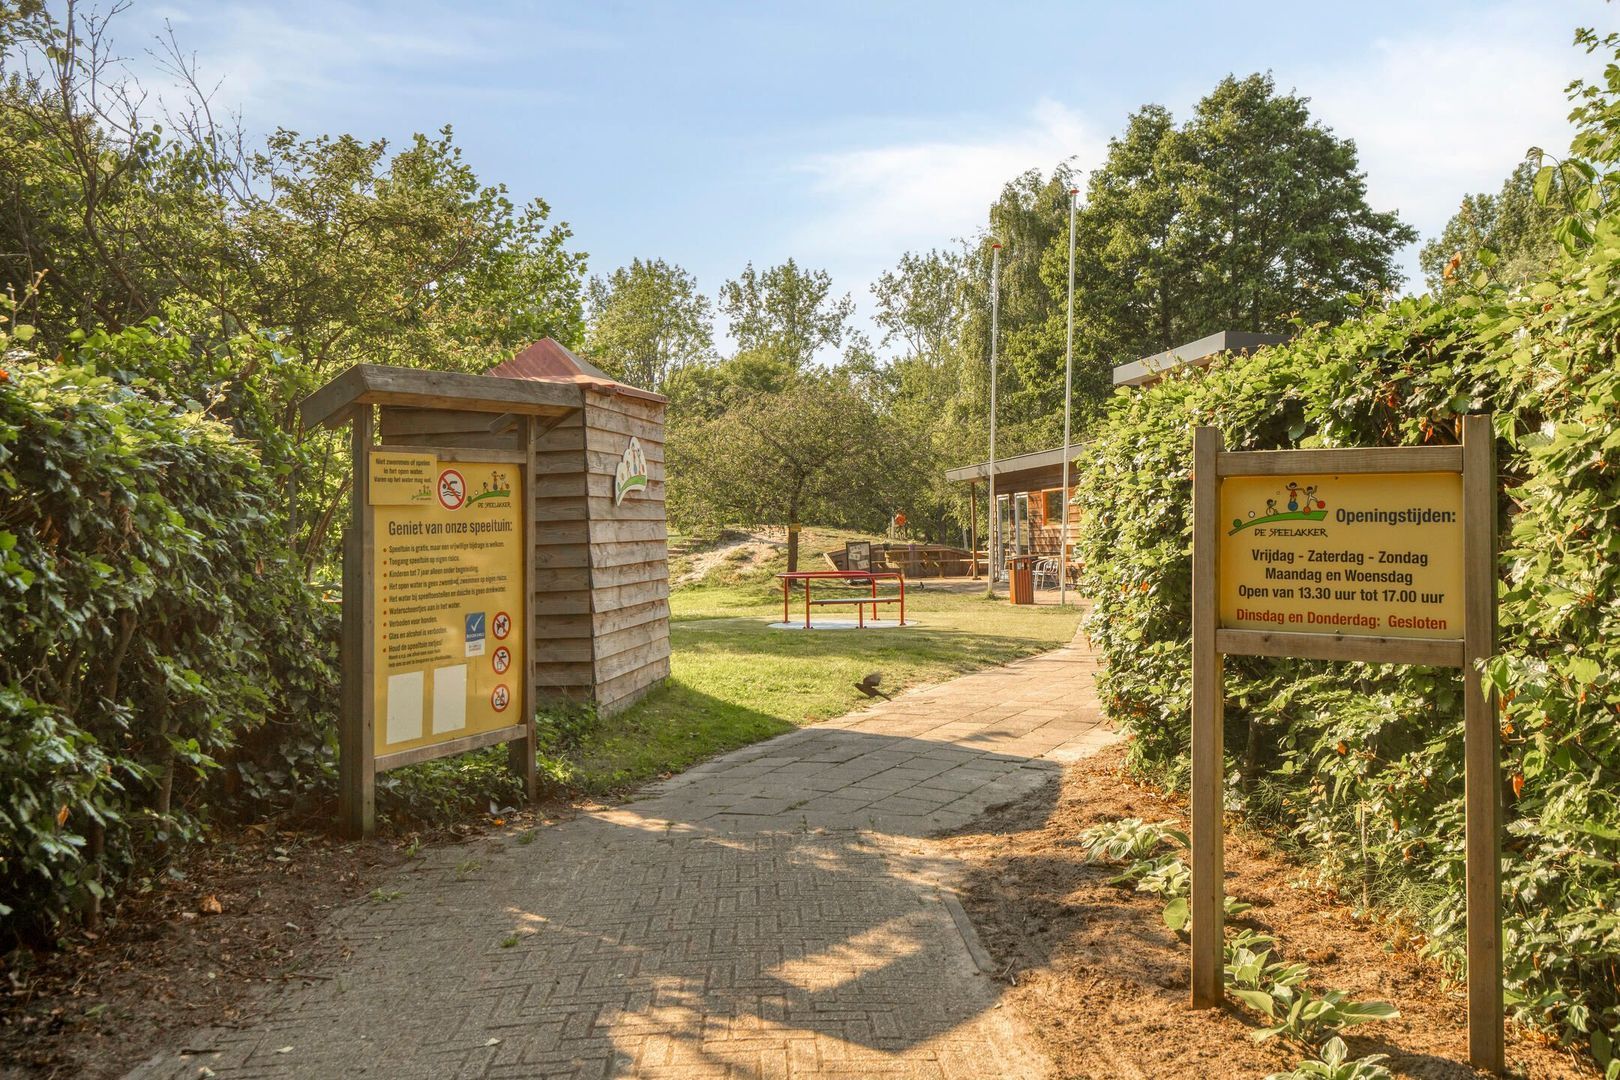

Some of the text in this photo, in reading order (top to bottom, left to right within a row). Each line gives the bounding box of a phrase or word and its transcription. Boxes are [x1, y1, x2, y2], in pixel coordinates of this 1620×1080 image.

[1336, 508, 1456, 526] Openingstijden:
[388, 519, 512, 536] Geniet van onze speeltuin:
[1254, 528, 1328, 538] DE SPEELAKKER
[1252, 549, 1294, 564] Vrijdag
[1308, 550, 1364, 566] Zaterdag
[1378, 551, 1428, 566] Zondag
[1266, 568, 1413, 586] Maandag en Woensdag
[1238, 585, 1444, 604] Open van 13.30 uur tot 17.00 uur
[1236, 608, 1447, 630] Dinsdag en Donderdag: Gesloten
